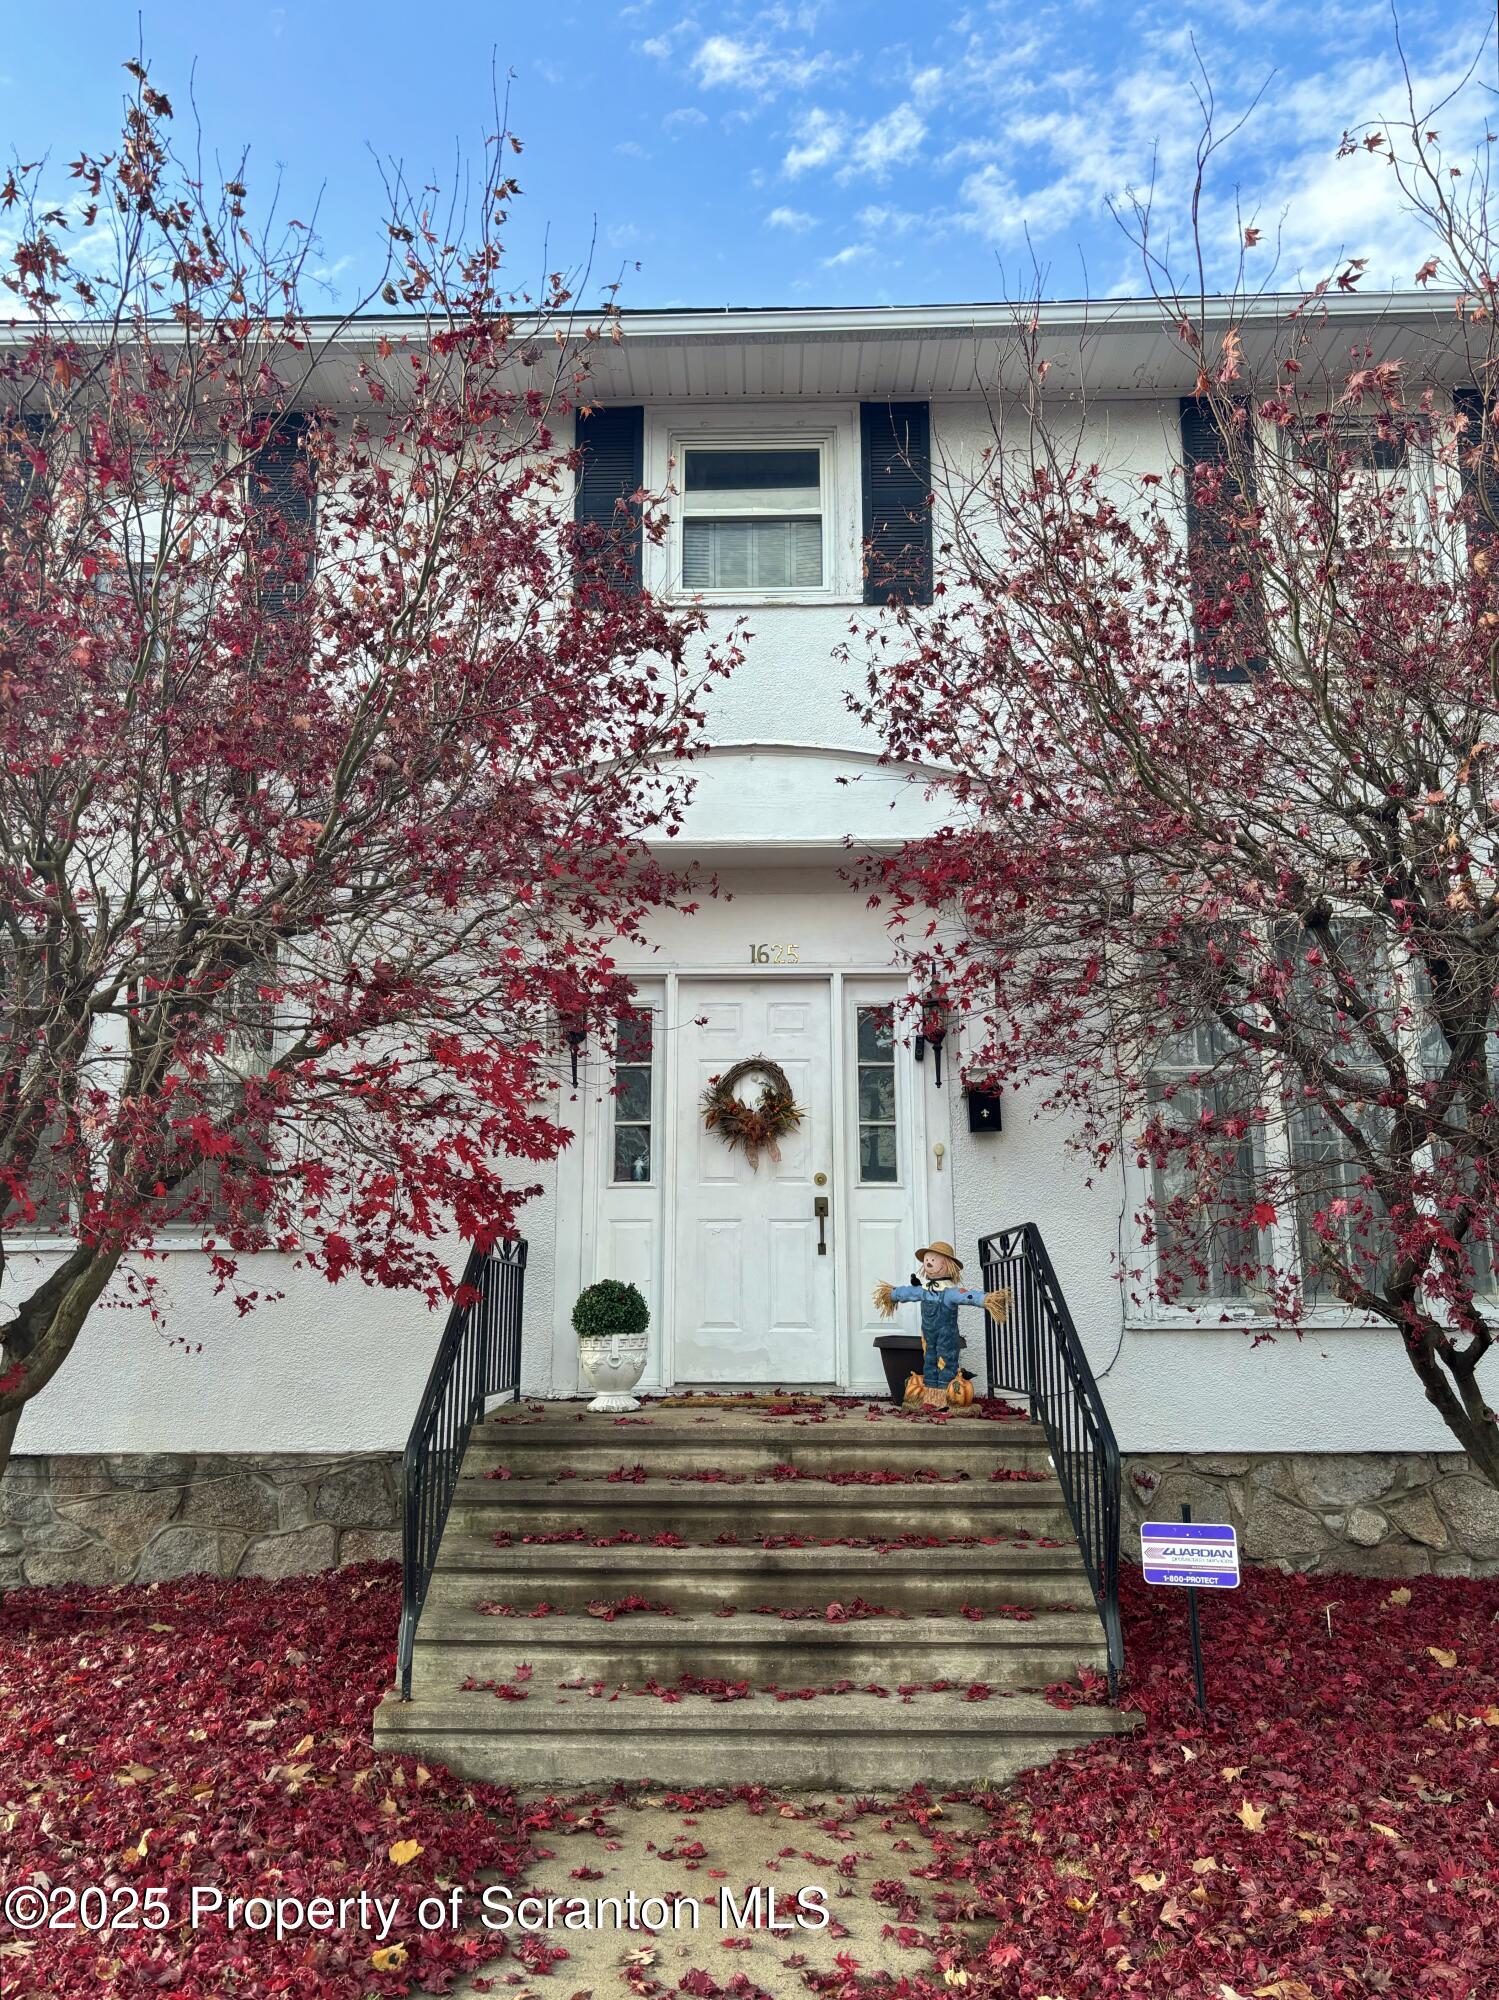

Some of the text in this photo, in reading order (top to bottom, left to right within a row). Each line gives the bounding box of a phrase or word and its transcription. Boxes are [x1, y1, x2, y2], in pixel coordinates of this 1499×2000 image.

[749, 944, 800, 964] 1625
[1162, 1547, 1233, 1558] GUARDIAN
[1163, 1575, 1219, 1585] 1-800-PROTECT
